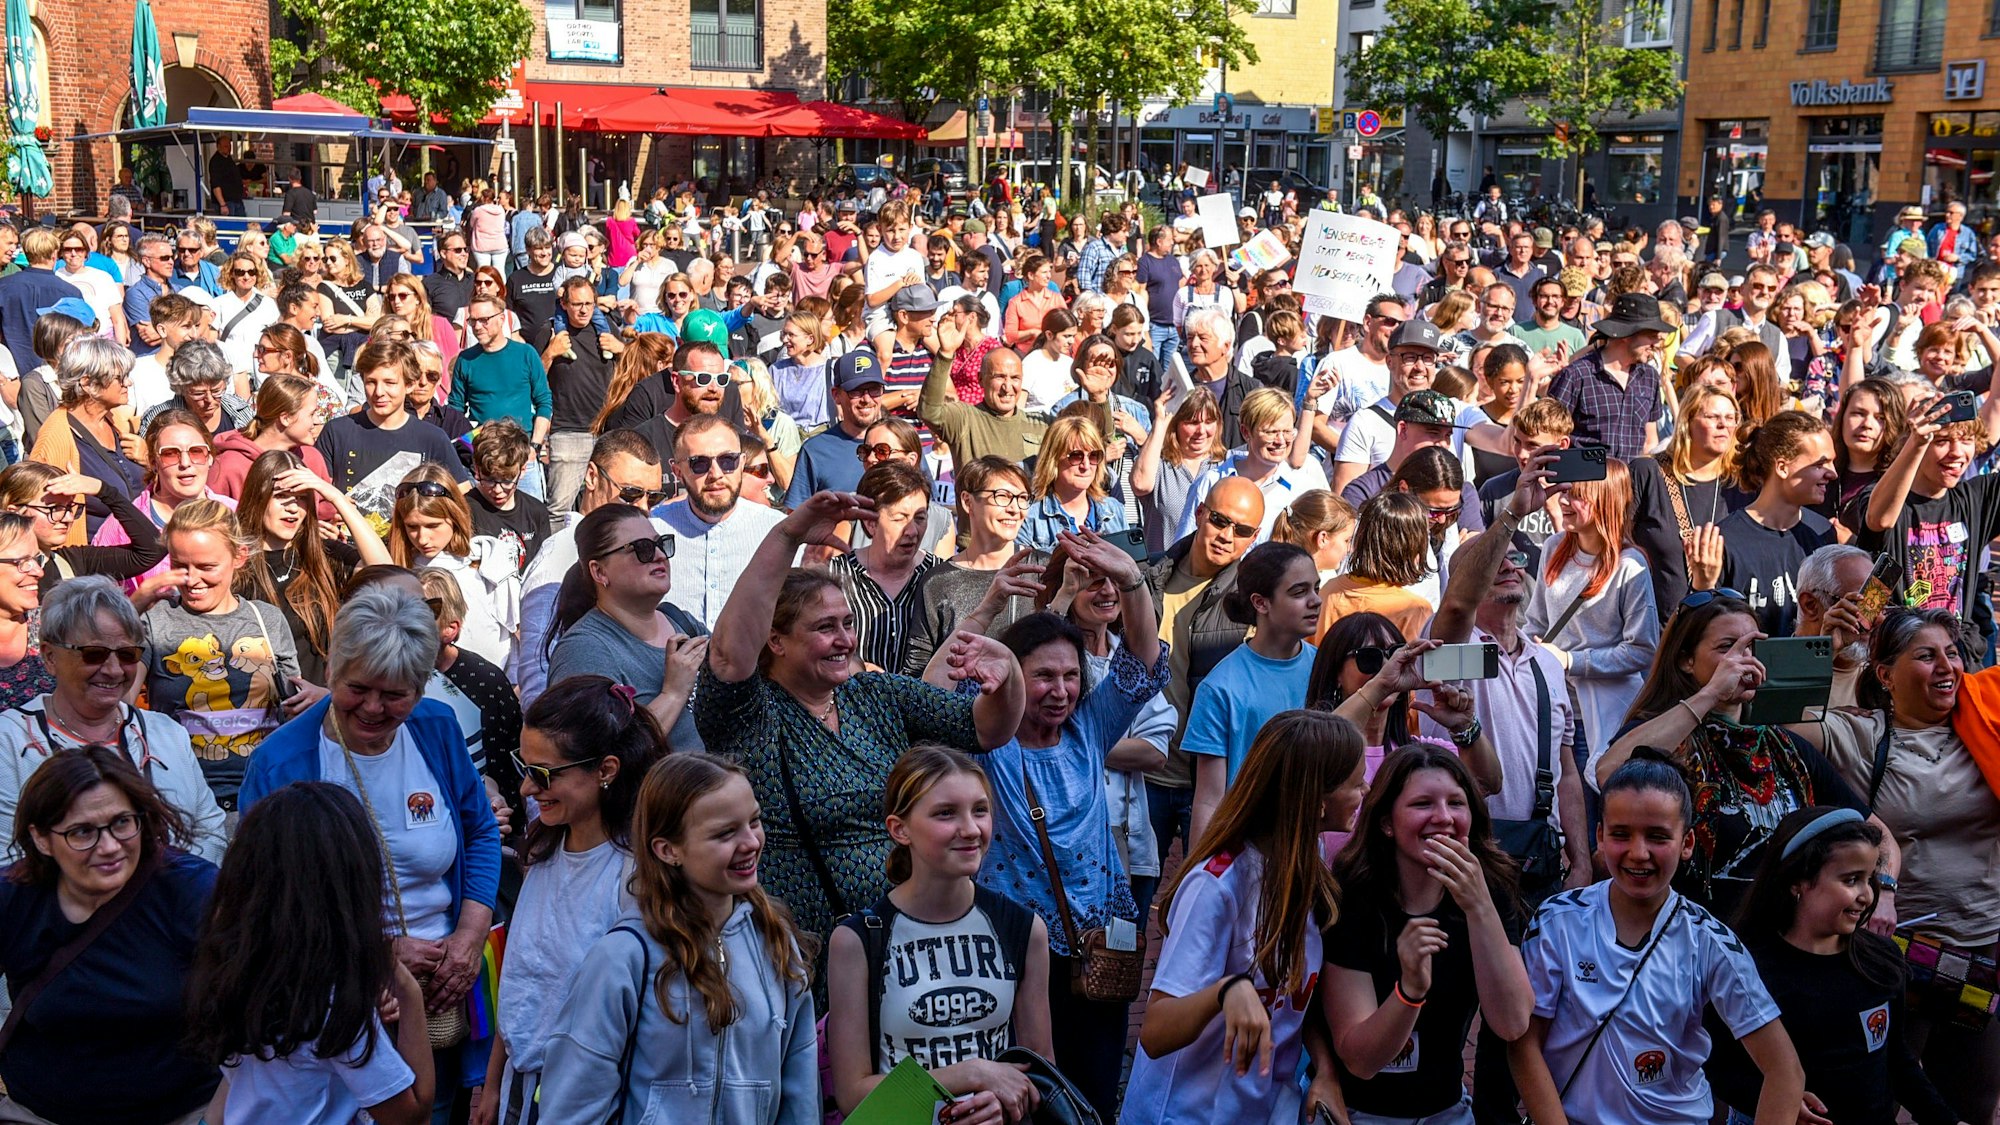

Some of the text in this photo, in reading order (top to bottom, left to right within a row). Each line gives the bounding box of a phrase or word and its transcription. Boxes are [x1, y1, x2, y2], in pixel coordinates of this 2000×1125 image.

[1790, 76, 1893, 106] Volksbank
[1144, 110, 1171, 123] Café
[1199, 112, 1283, 125] Bärei Café
[1315, 245, 1341, 257] STATT
[1575, 975, 1599, 984] hummel
[924, 991, 982, 1023] 1992
